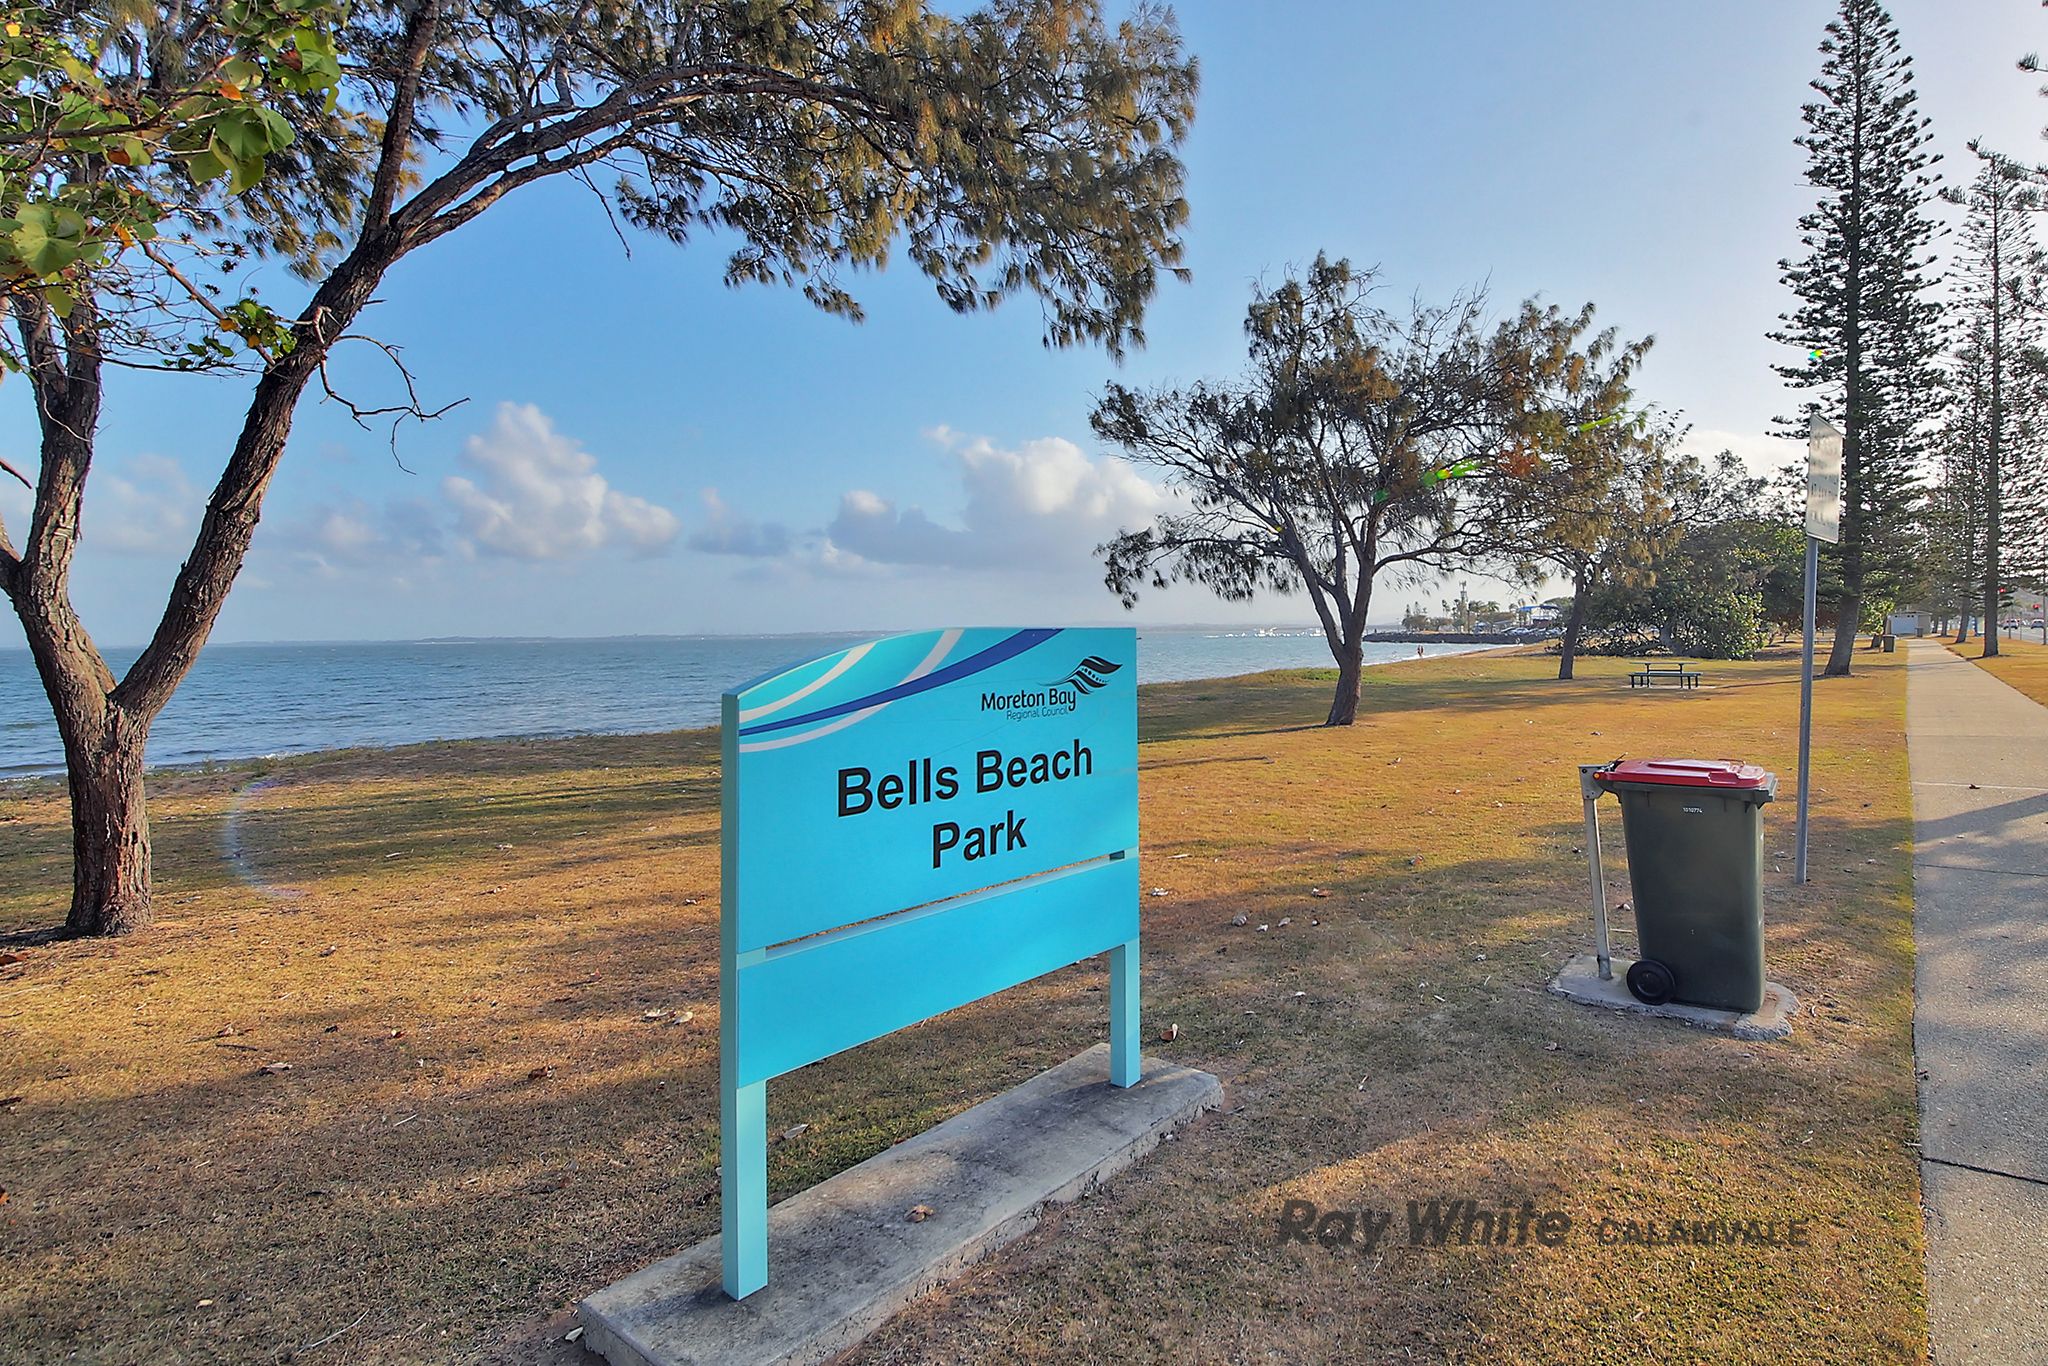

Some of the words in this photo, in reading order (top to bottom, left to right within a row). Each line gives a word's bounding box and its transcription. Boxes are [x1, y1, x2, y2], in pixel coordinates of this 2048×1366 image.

[981, 689, 1045, 711] Moreton
[1049, 688, 1076, 711] Bay
[1006, 708, 1040, 722] Regional
[1041, 706, 1068, 718] Council
[837, 757, 959, 818] Bells
[976, 738, 1093, 794] Beach
[932, 810, 1028, 869] Park
